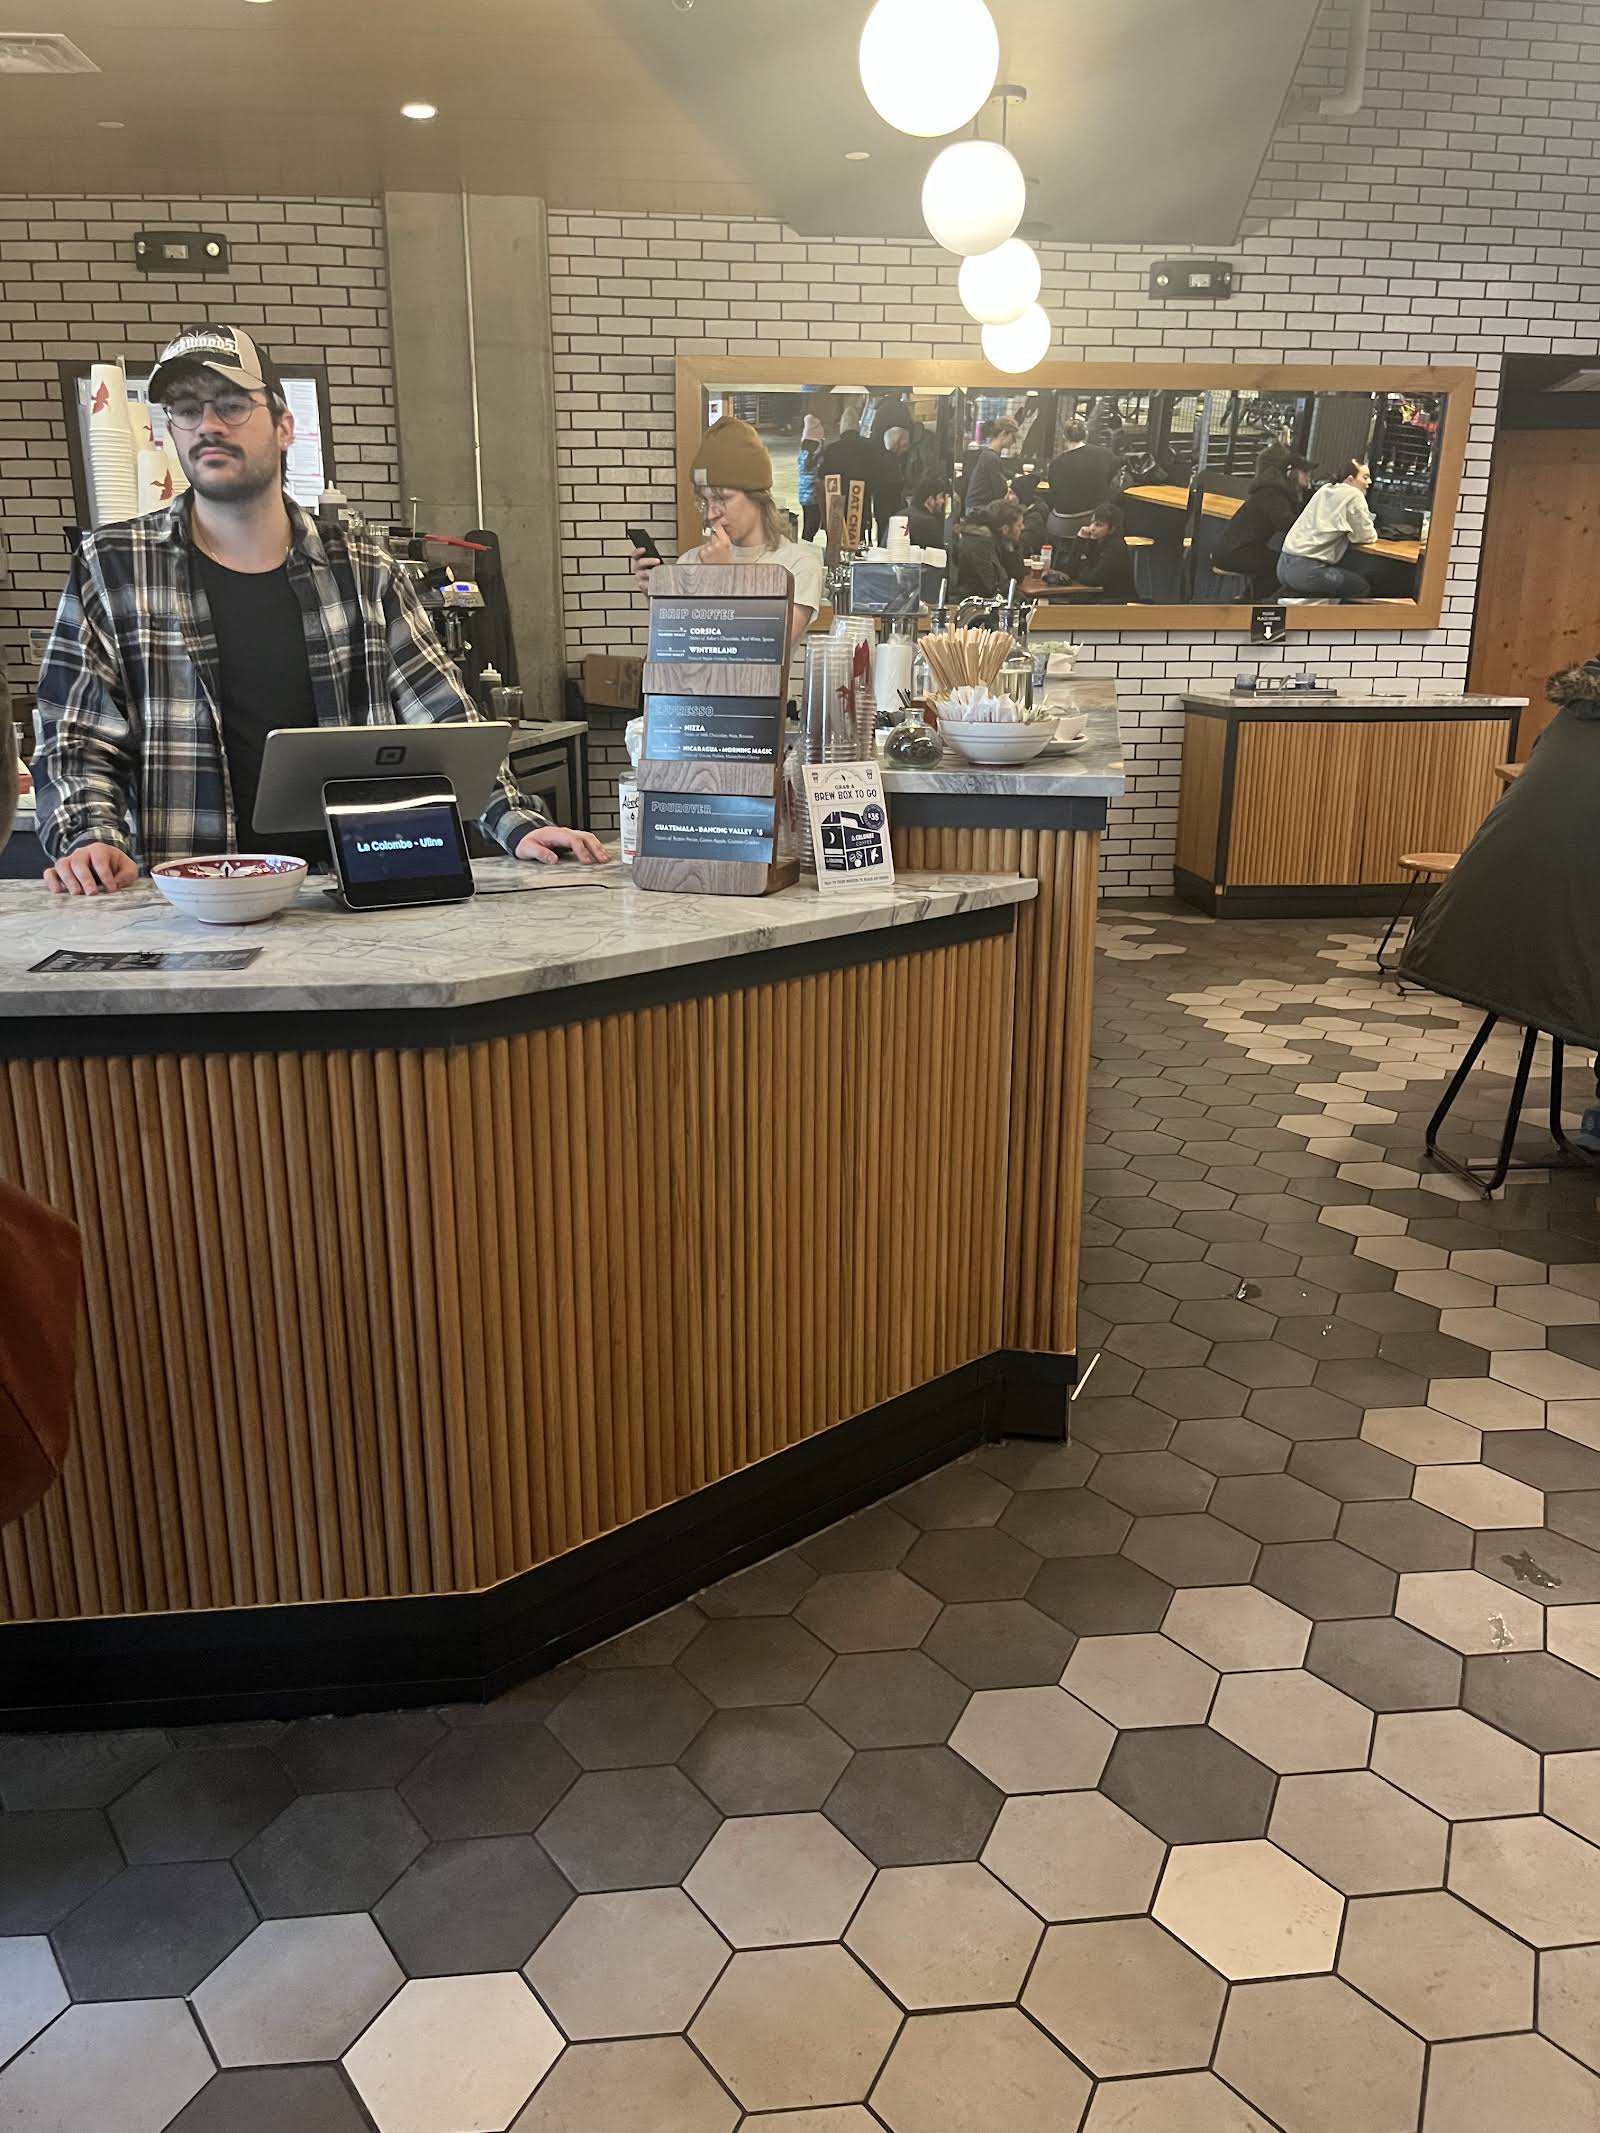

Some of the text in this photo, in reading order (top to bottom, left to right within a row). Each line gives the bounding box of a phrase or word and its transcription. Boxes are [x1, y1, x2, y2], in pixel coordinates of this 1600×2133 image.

[851, 485, 861, 513] OAT
[659, 608, 735, 620] DRIP COFFEE
[689, 627, 722, 635] CORSICA
[688, 646, 738, 655] WINTERLAND
[684, 724, 706, 732] NIZZA
[682, 745, 718, 753] NICARAGUA
[722, 746, 751, 754] MORNING
[751, 747, 773, 755] MAGIC
[814, 788, 877, 801] BREW BOX TO GO
[651, 801, 712, 815] POUROVER
[868, 812, 880, 821] $35
[654, 824, 695, 833] GUATEMALA
[698, 826, 728, 835] DANCING
[728, 827, 753, 836] VALLEY
[356, 842, 371, 853] La
[371, 840, 413, 852] Colombe
[419, 837, 444, 848] Uline
